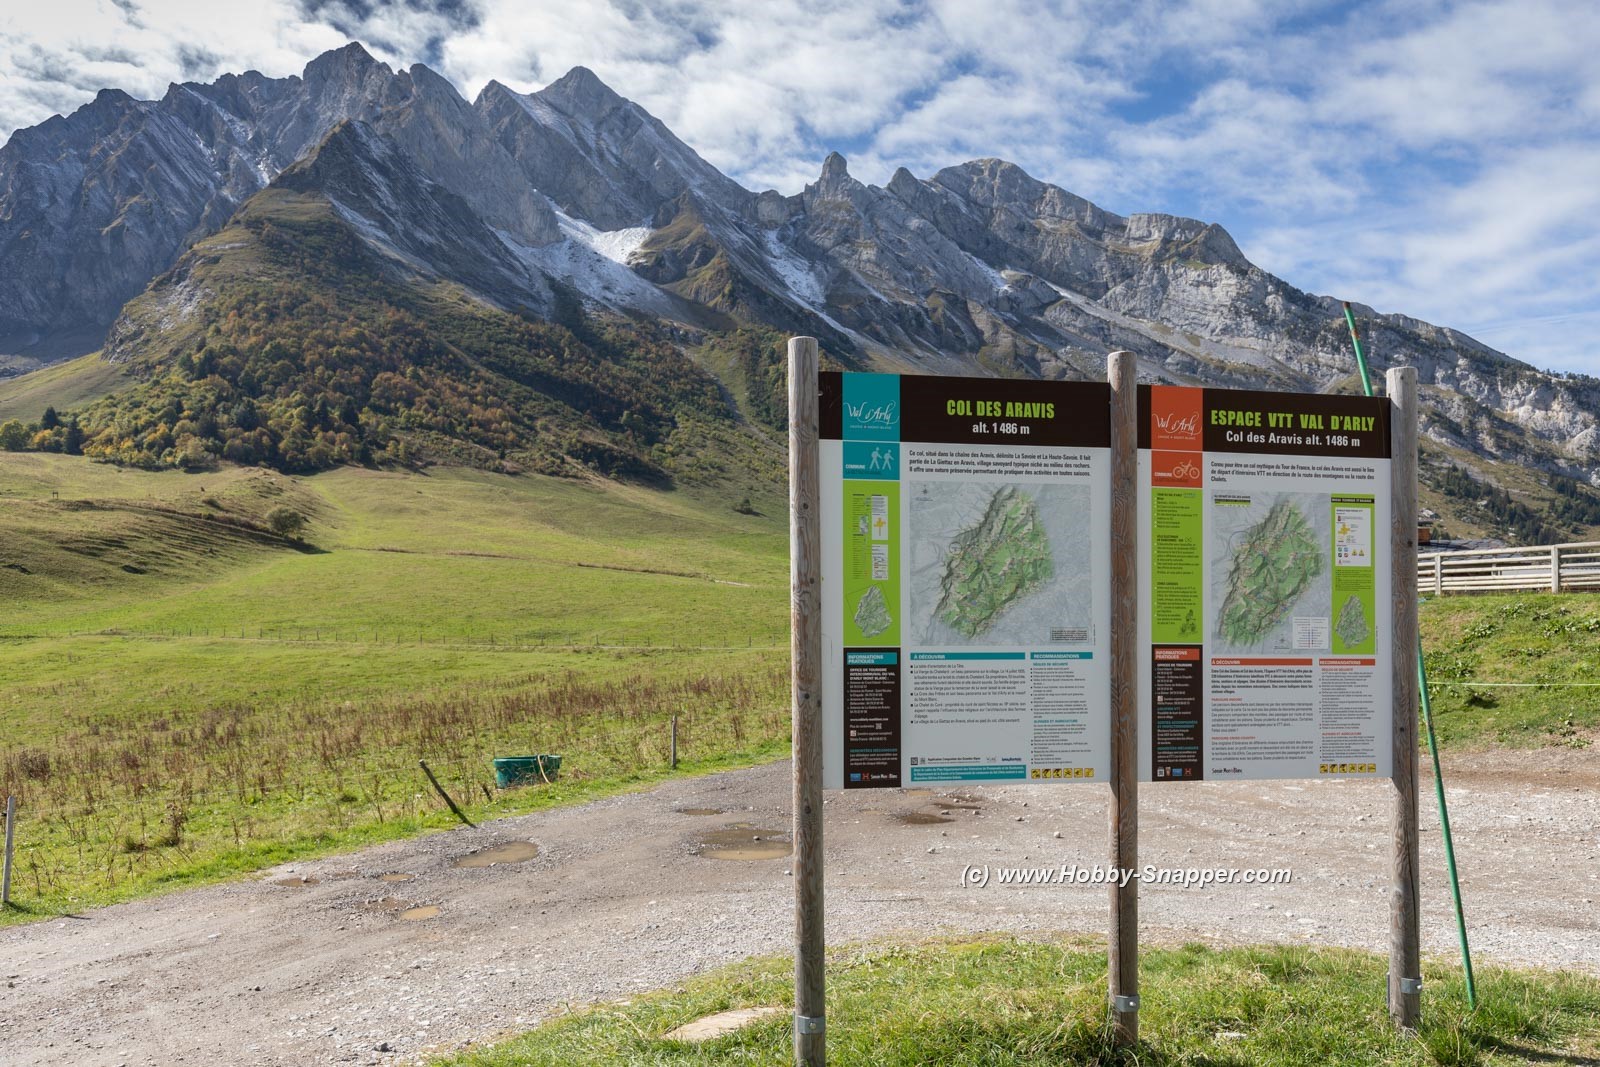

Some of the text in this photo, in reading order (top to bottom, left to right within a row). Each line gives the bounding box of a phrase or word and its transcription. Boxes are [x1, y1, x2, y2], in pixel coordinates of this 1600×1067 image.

[947, 400, 1055, 419] COL DES ARAVIS
[972, 422, 989, 433] alt.
[1020, 426, 1030, 435] m
[1211, 410, 1374, 431] ESPACE VTT VAL D'ARLY
[1226, 430, 1360, 447] Col des Aravis alt. 1486 m
